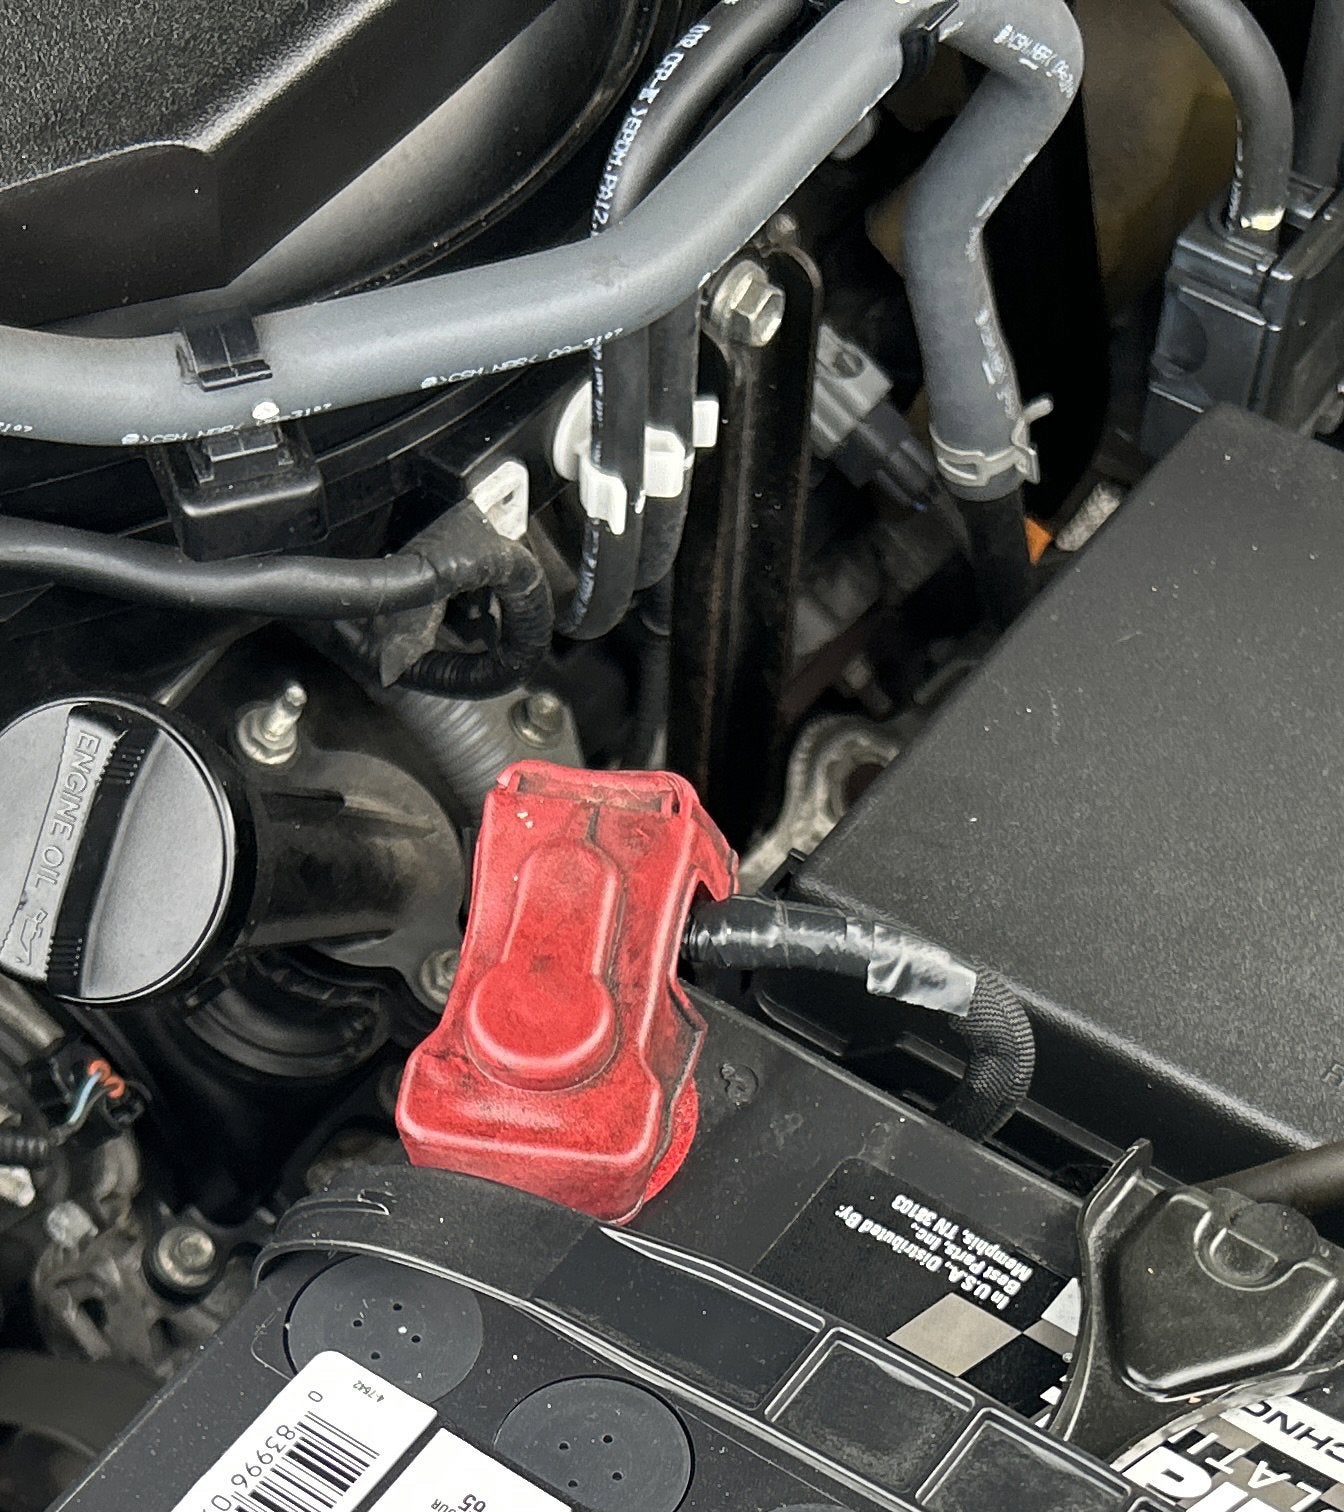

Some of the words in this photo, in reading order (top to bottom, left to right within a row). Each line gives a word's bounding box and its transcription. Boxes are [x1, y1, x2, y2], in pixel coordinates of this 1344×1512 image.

[49, 729, 101, 841] ENGINE
[34, 845, 65, 888] OIL
[829, 1200, 868, 1229] By:
[930, 1216, 963, 1240] TN
[855, 1216, 946, 1273] Distributed
[935, 1239, 989, 1276] Parts,
[952, 1226, 1039, 1282] Memphis,
[934, 1259, 997, 1301] U.S.A.,
[978, 1265, 1024, 1297] Best
[985, 1289, 1013, 1311] In
[304, 1387, 326, 1404] 0
[223, 1421, 301, 1492] 83996
